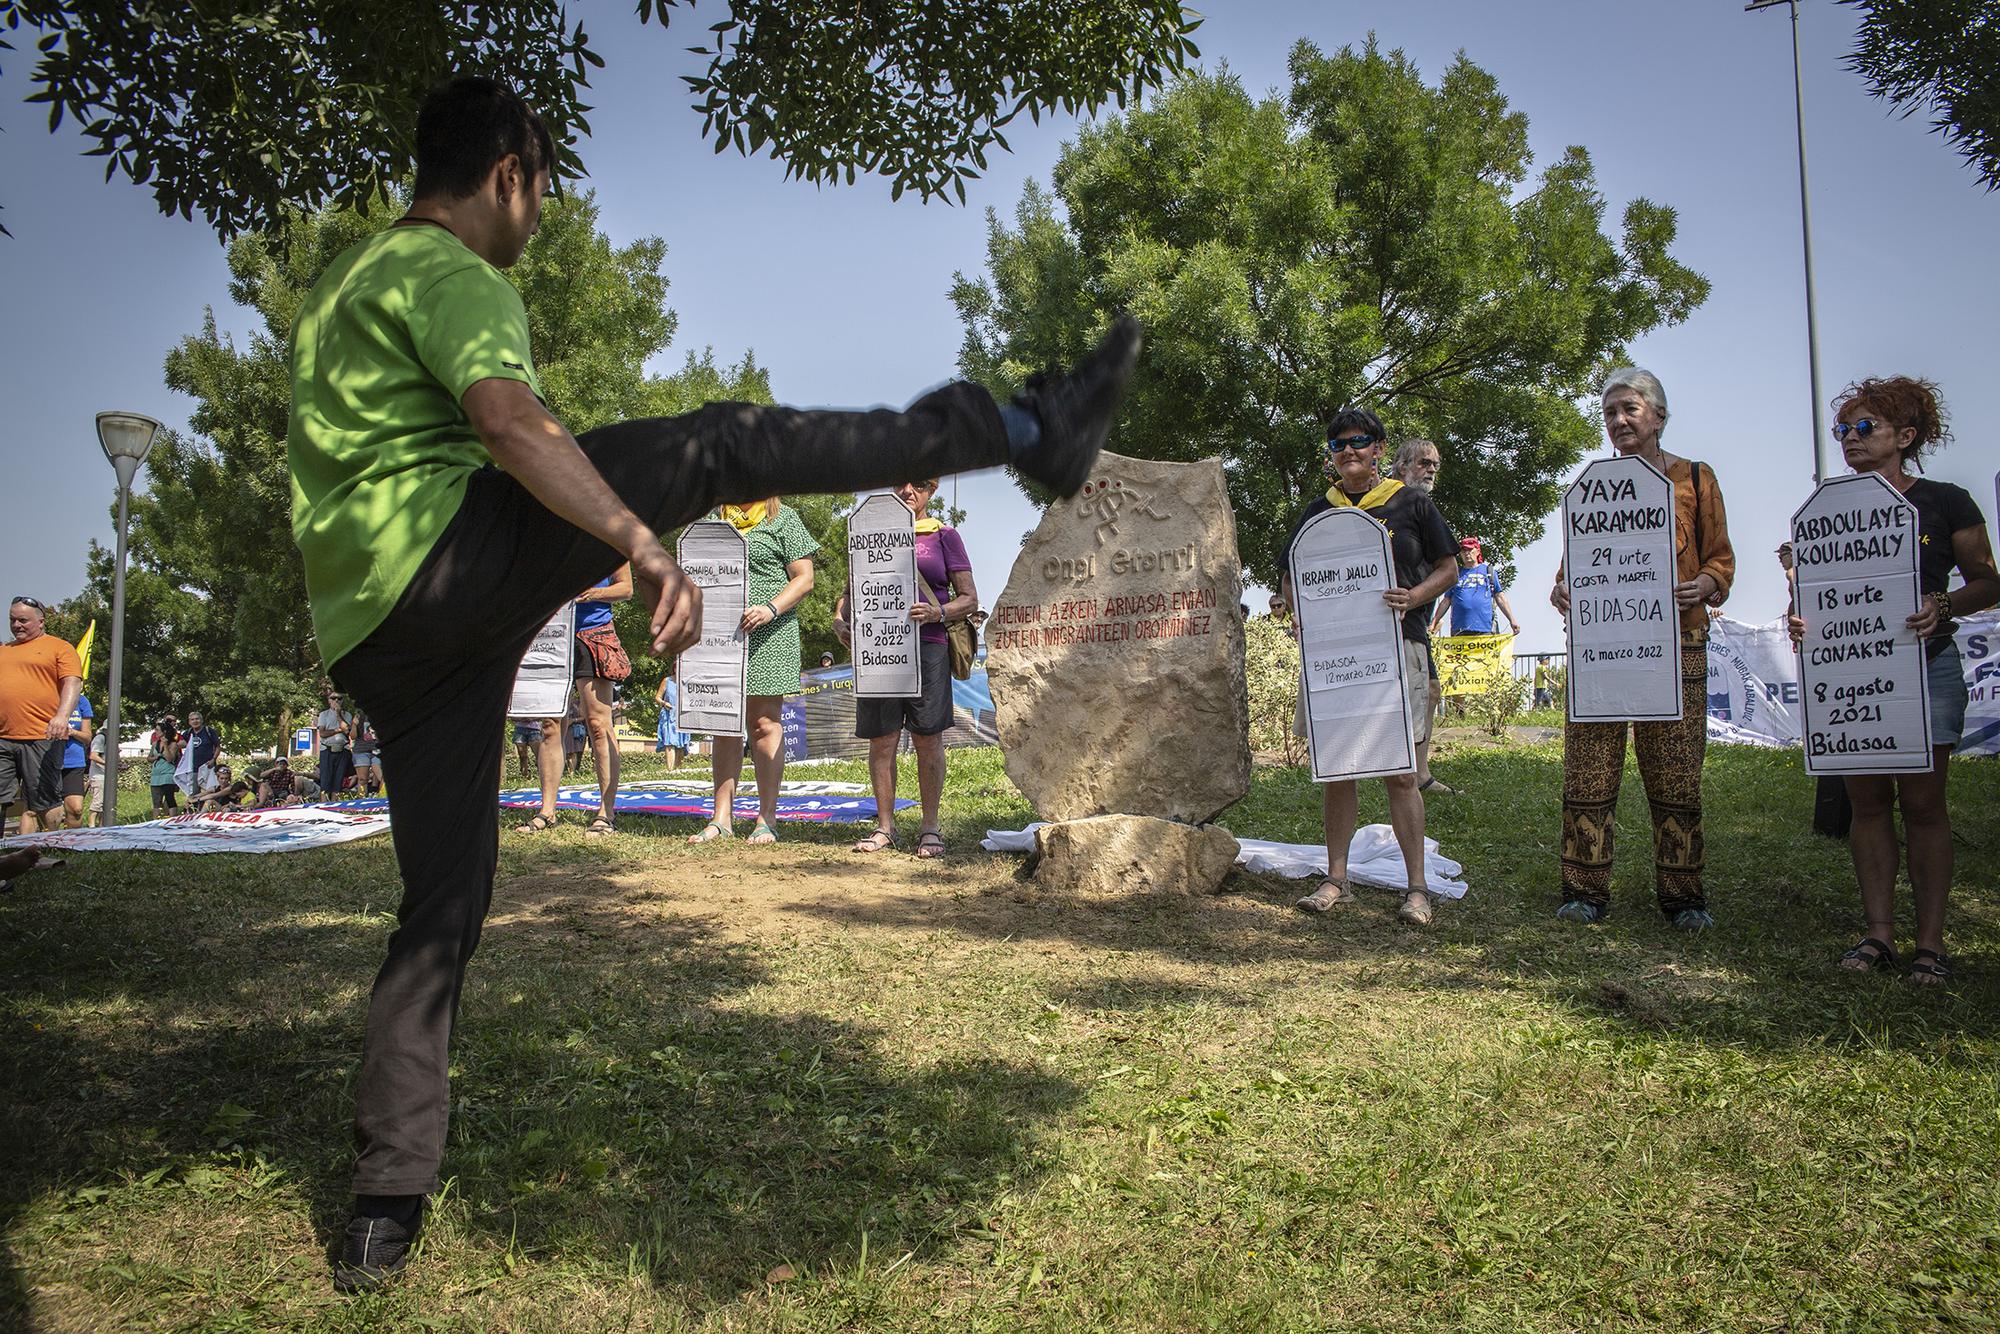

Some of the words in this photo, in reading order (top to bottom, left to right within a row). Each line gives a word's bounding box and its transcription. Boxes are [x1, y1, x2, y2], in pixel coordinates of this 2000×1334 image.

[1580, 479, 1636, 504] YAYA
[1571, 507, 1665, 536] KARAMOKO
[1794, 505, 1906, 543] ABDOULAYE
[850, 532, 914, 551] ABDERRAMAN
[1796, 533, 1904, 567] KOULABALY
[868, 549, 893, 563] BAS
[1592, 547, 1612, 567] 29
[1619, 549, 1651, 566] urte
[1302, 569, 1340, 587] IBRAHIM
[1345, 563, 1378, 581] DIALLO
[1573, 574, 1609, 588] COSTA
[861, 580, 903, 596] Guinea
[1317, 580, 1360, 597] Senegal
[1818, 588, 1838, 611] 18
[1845, 584, 1884, 606] urte
[863, 599, 879, 611] 25
[883, 597, 905, 610] urte
[997, 604, 1041, 625] HEMEN
[1049, 599, 1097, 622] AZKEN
[1104, 593, 1166, 617] ARNASA
[1172, 587, 1217, 611] EMAN
[861, 623, 873, 637] 18
[881, 621, 911, 635] Junio
[1822, 616, 1886, 640] GUINEA
[874, 635, 904, 646] 2022
[994, 627, 1040, 650] ZUTEN
[1443, 642, 1465, 652] Ongi
[862, 650, 908, 665] Bidasoa
[1582, 649, 1595, 663] 12
[1599, 649, 1633, 661] marzo
[1637, 645, 1662, 659] 2022
[1811, 639, 1895, 665] CONAKRY
[1314, 656, 1357, 672] BIDASOA
[1365, 663, 1388, 676] 2022
[687, 682, 719, 694] BIDASOA
[1814, 682, 1828, 703] 8
[1834, 677, 1894, 707] agosto
[689, 699, 706, 708] 2021
[1829, 705, 1881, 725] 2021
[1811, 732, 1897, 756] Bidasoa
